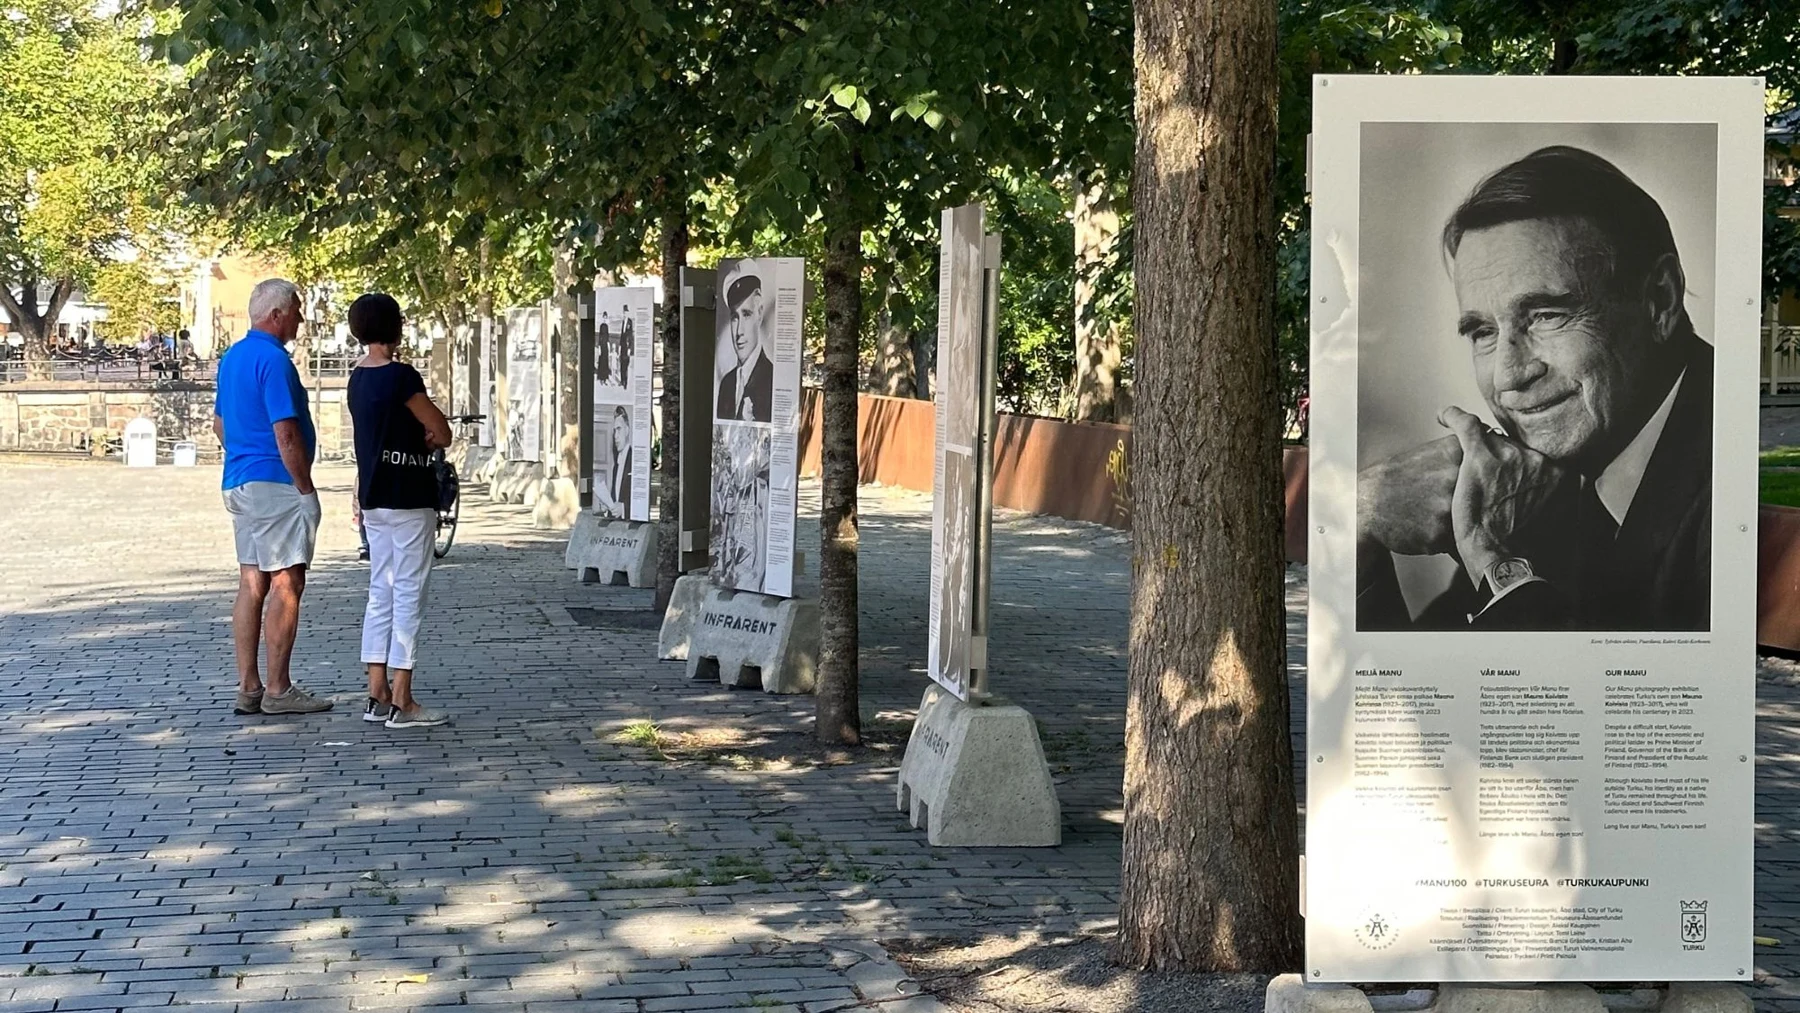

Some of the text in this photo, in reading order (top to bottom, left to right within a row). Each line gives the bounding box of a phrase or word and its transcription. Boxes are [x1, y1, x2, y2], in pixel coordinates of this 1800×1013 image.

[590, 536, 638, 549] INFRARENT
[704, 612, 777, 636] INFRARENT
[1415, 878, 1649, 887] MANU100 @TURKUSEURA @TURKUKAUPUNKI
